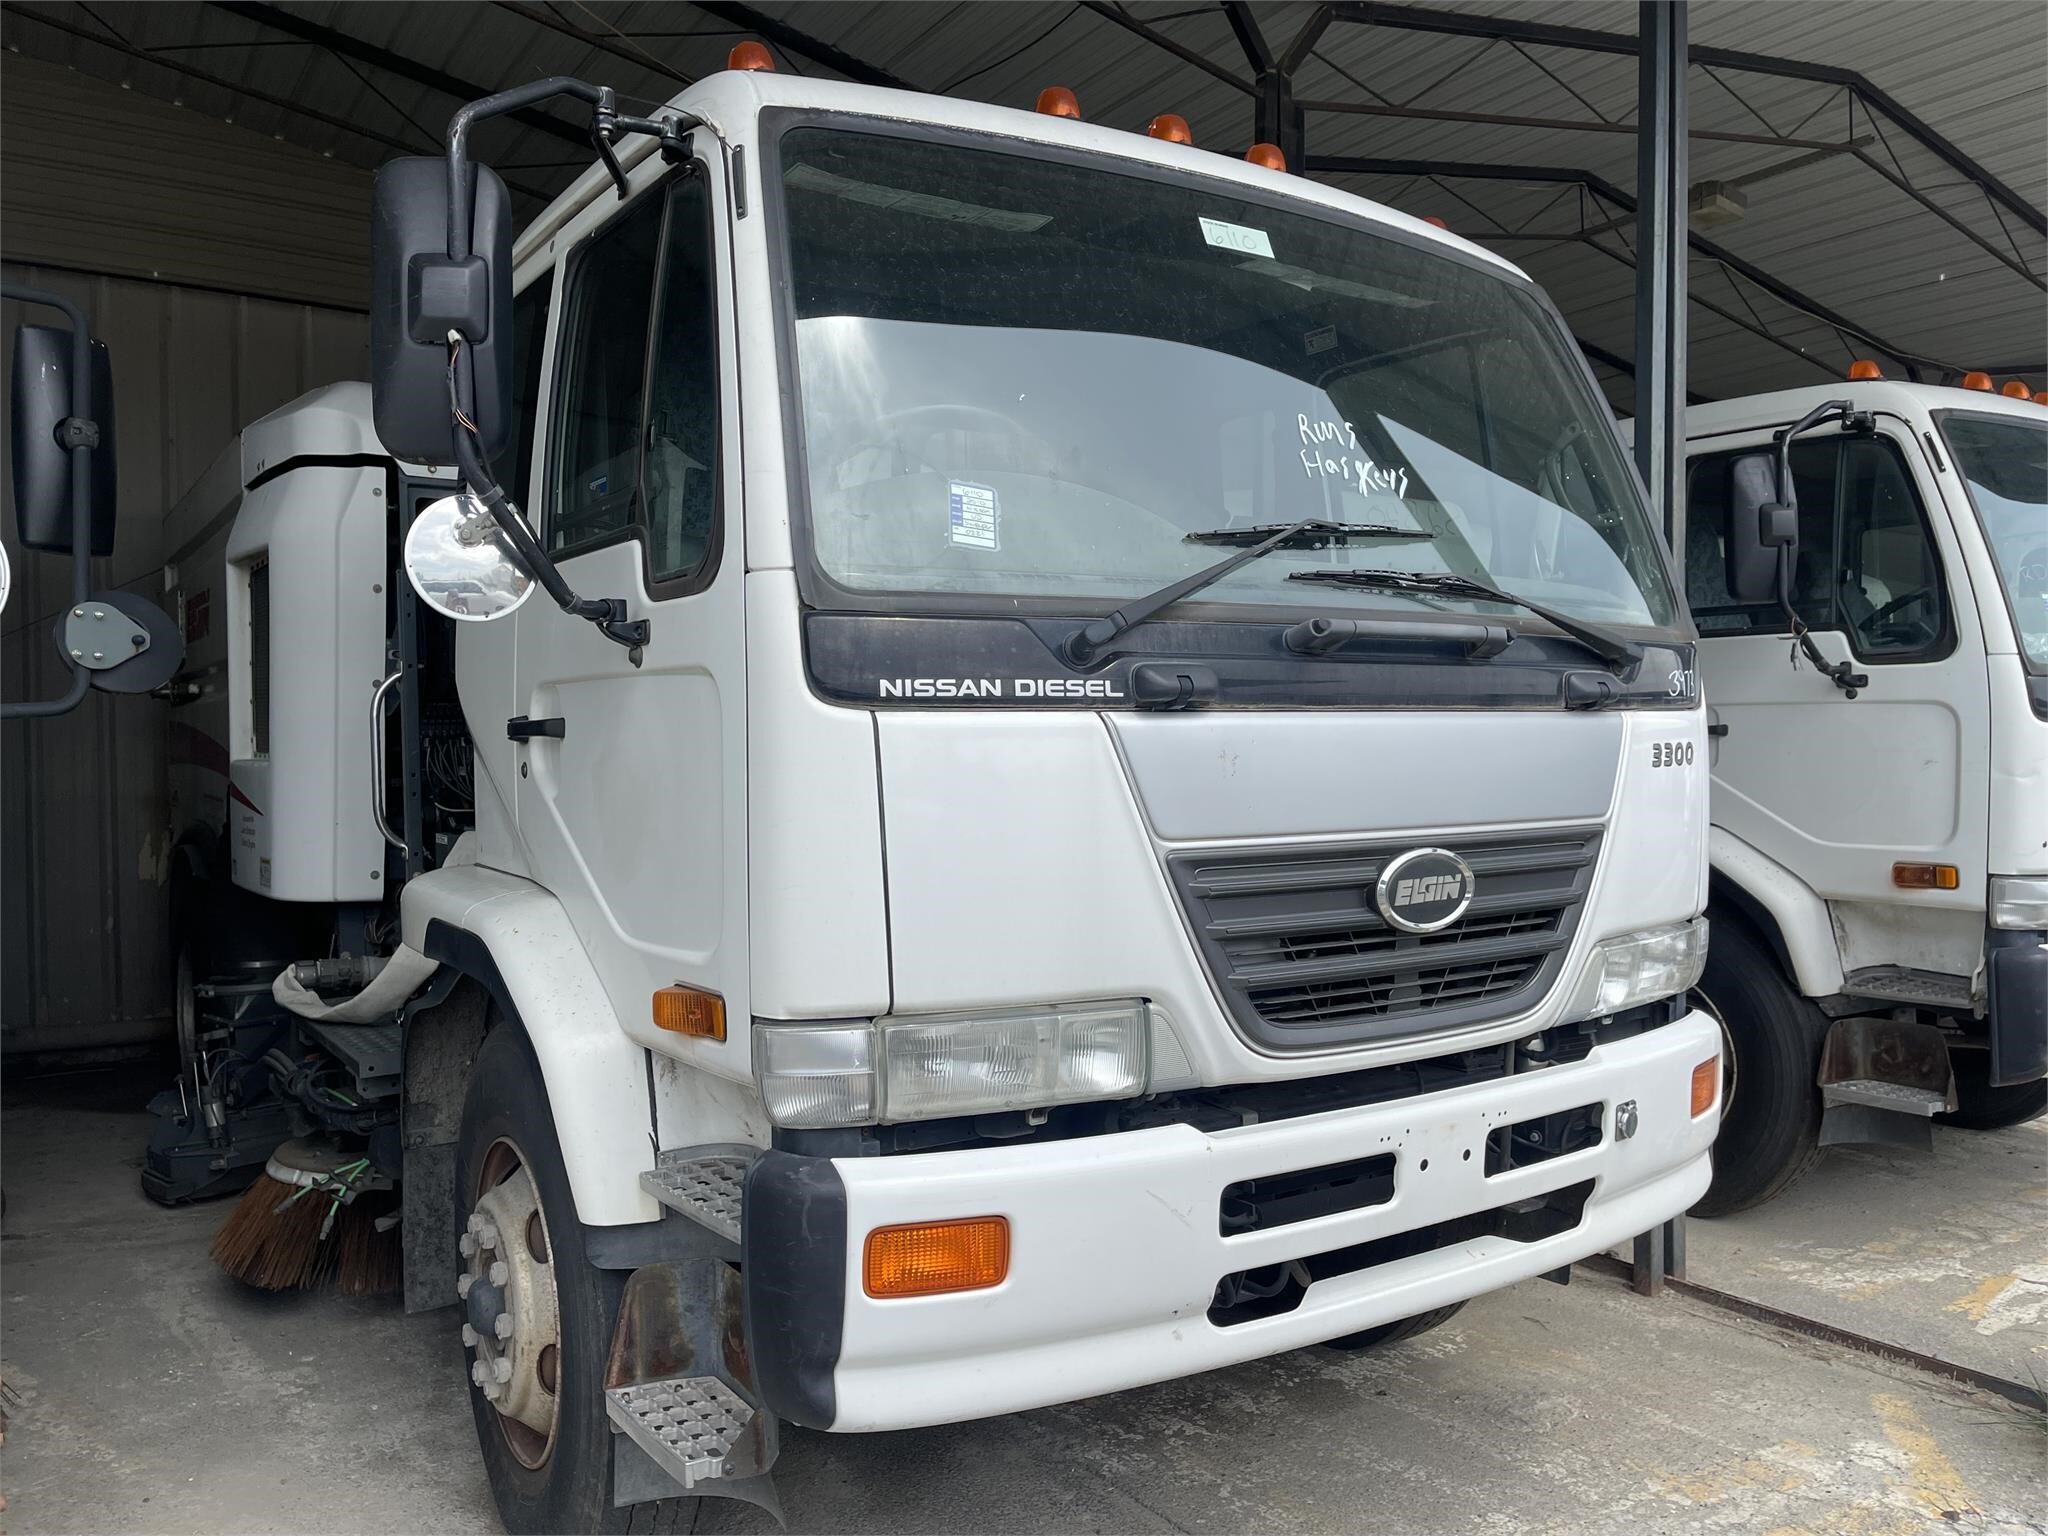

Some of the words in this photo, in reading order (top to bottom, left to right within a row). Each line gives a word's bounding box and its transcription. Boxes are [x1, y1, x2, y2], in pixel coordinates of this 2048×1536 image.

[1297, 413, 1356, 450] Runs
[1300, 449, 1349, 480] Has
[879, 679, 1001, 697] NISSAN
[1014, 679, 1124, 697] DIESEL
[1651, 741, 1694, 768] 3300
[1394, 873, 1462, 907] ELGIN
